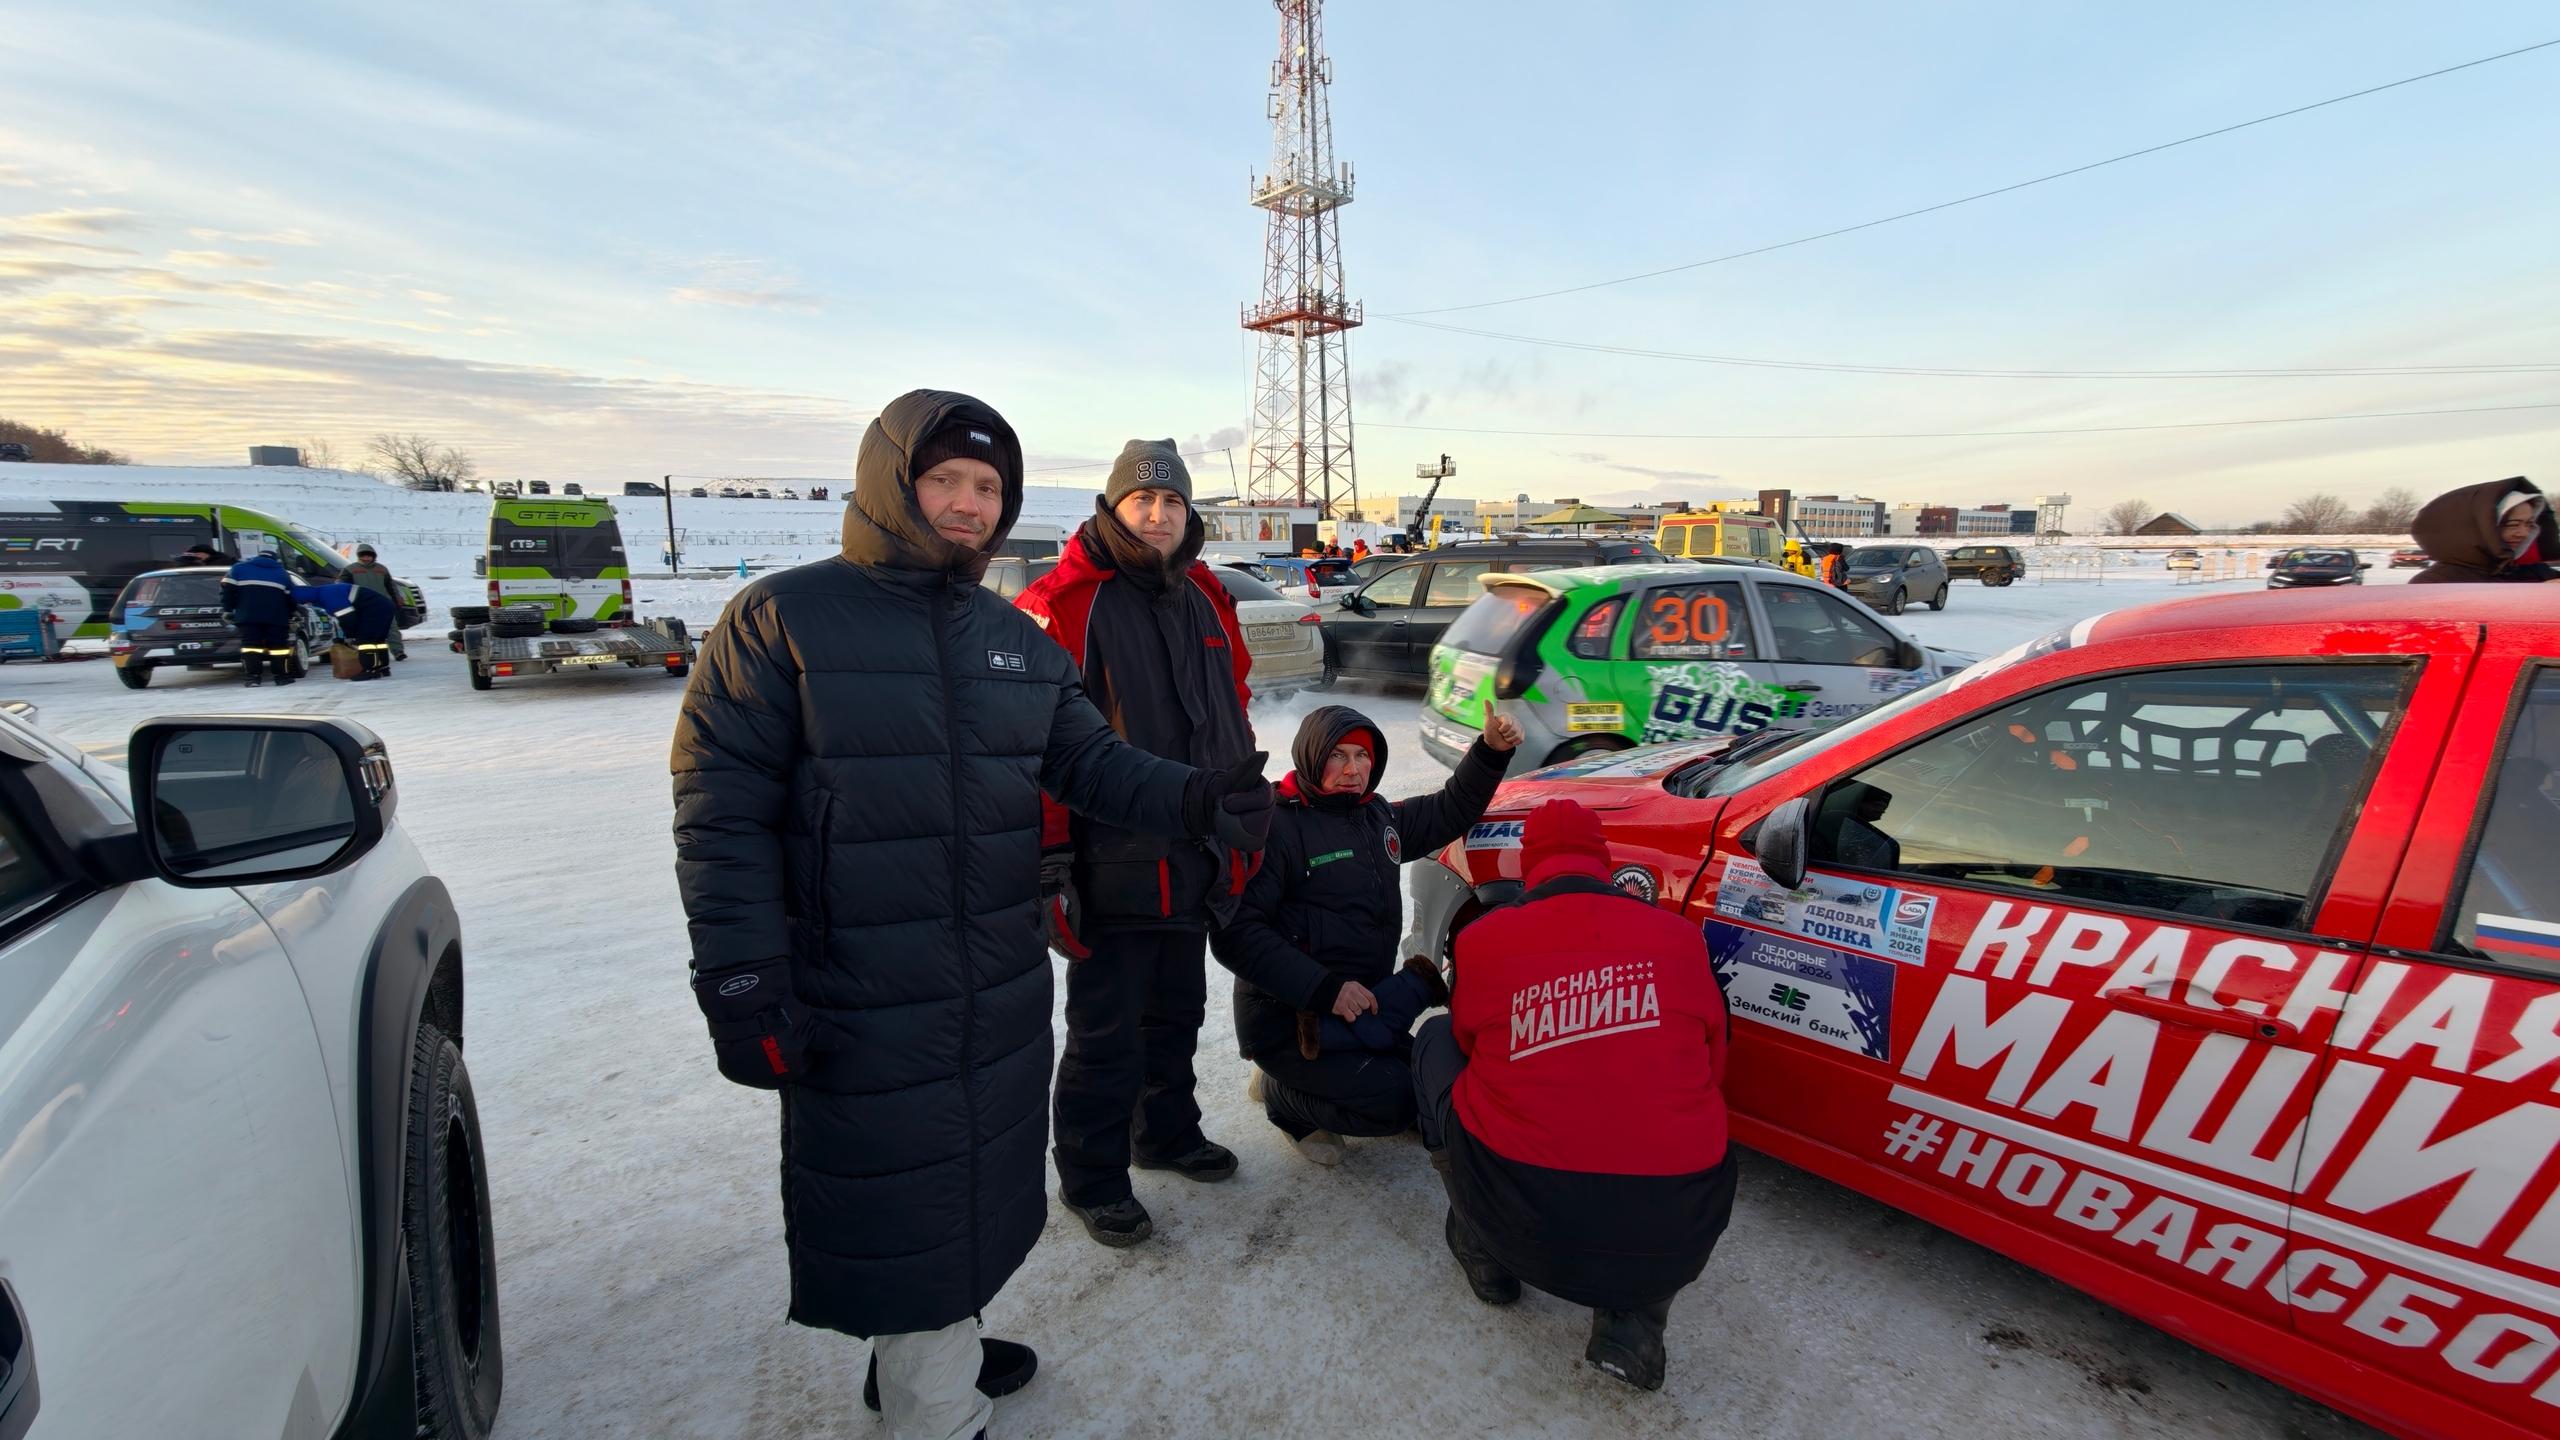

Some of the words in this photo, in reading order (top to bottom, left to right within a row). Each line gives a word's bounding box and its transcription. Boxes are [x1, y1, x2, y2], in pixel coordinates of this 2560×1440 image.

[970, 431, 991, 444] PUMA
[1136, 460, 1171, 481] 86
[0, 538, 83, 551] ERT
[1652, 597, 1728, 642] 30
[1654, 684, 1774, 737] GUS
[1727, 874, 1752, 885] КУБОК
[1729, 867, 1755, 878] КУБОК
[1728, 885, 1746, 894] ЭТАП
[1720, 904, 1743, 917] КВЦ
[1805, 904, 1877, 930] ЛЕДОВАЯ
[1903, 905, 1922, 914] LADA
[1801, 919, 1873, 949] ГОНКА
[1889, 931, 1923, 944] ЯНВАРЯ
[1897, 926, 1918, 936] 16-18
[1758, 942, 1827, 968] ЛЕДОВЫЕ
[1888, 938, 1922, 954] 2026
[1888, 949, 1921, 961] ТОЛЬЯТТИ
[1751, 951, 1796, 972] ГОНКИ
[1799, 964, 1832, 981] 2026
[1512, 966, 1613, 1015] КРАСНАЯ
[1510, 983, 1660, 1052] МАШИНА
[1731, 996, 1801, 1026] Земский
[1808, 1019, 1850, 1041] банк
[1883, 1113, 2560, 1409] #НОВАЯСБО
